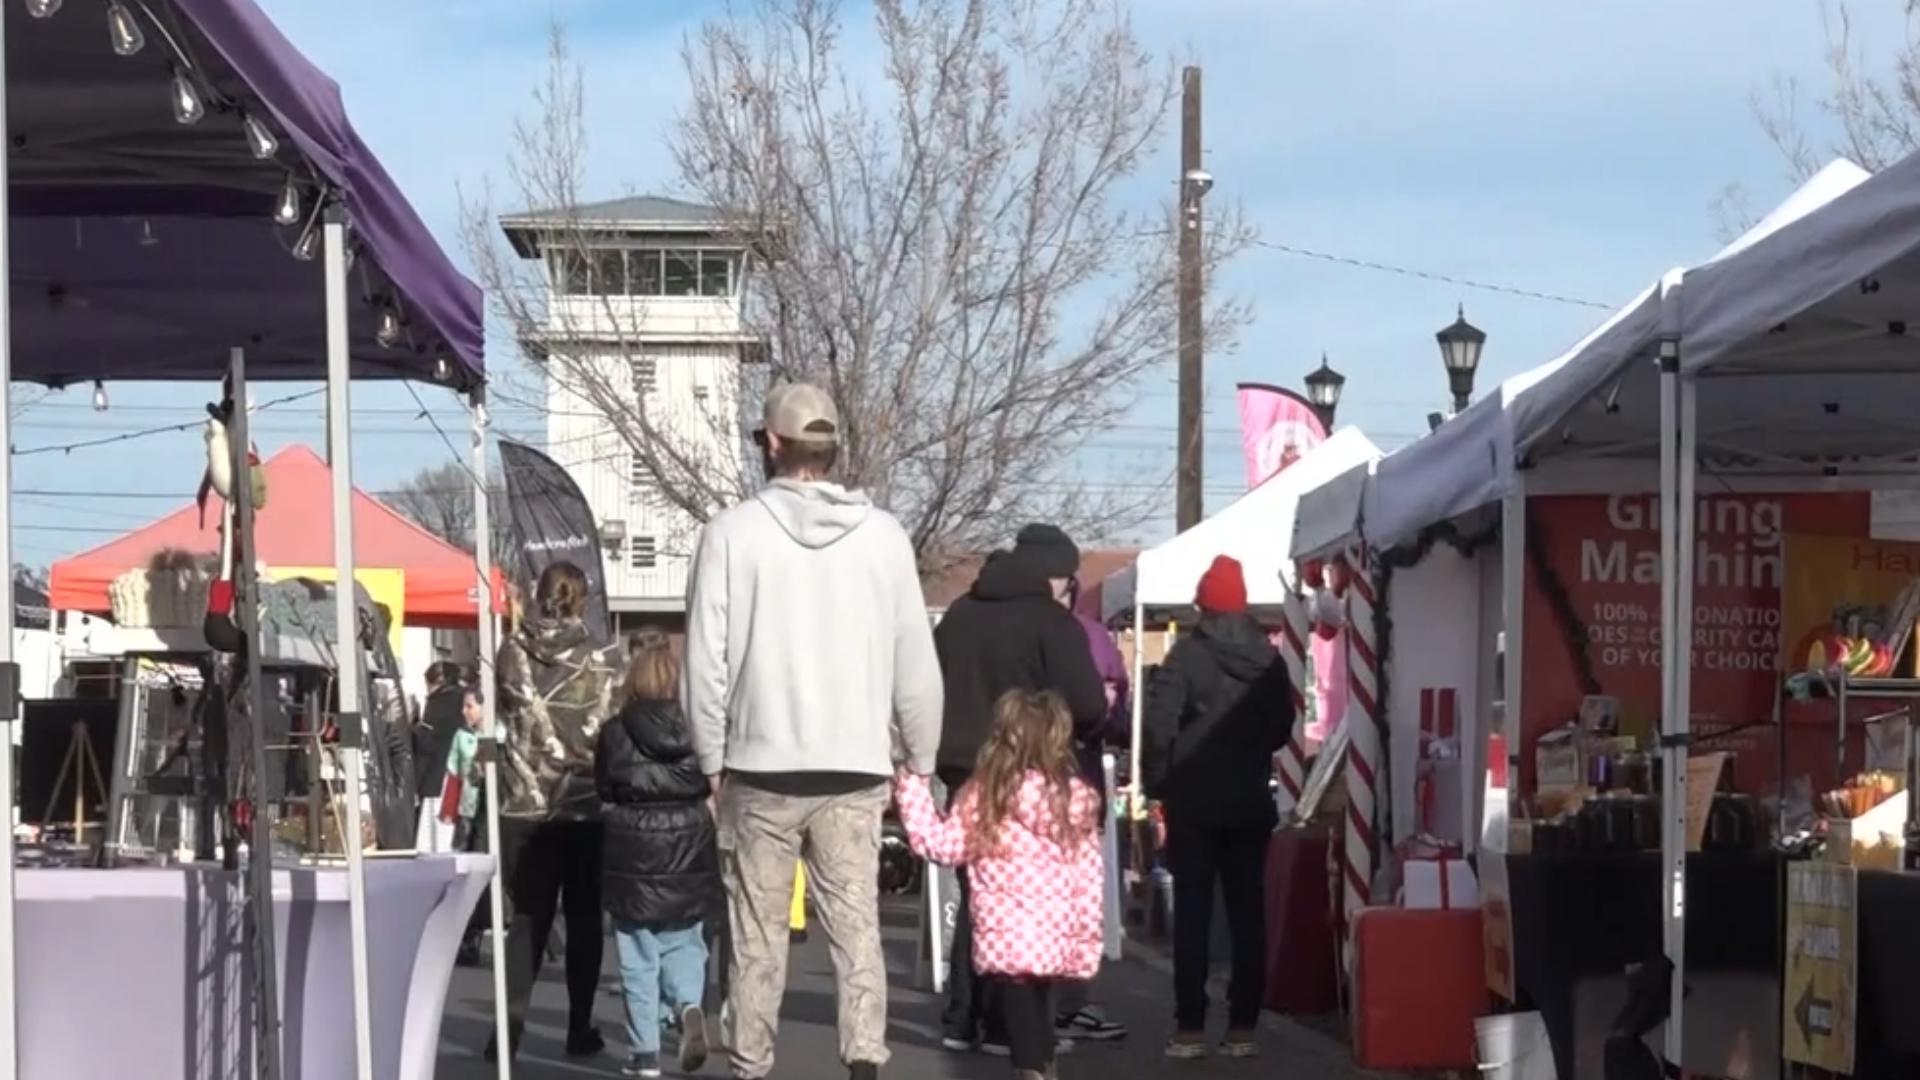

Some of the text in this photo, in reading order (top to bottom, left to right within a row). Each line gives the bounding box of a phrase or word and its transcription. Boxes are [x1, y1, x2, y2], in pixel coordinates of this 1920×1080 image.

[1607, 494, 1781, 546] Giing
[1581, 539, 1781, 589] Mahin
[1850, 543, 1920, 574] Ha
[1592, 602, 1649, 623] 100%
[1695, 606, 1779, 626] ONATIO
[1588, 625, 1628, 643] OES
[1649, 627, 1742, 647] CRITY
[1747, 630, 1779, 648] CA
[1602, 647, 1632, 665] OF
[1636, 648, 1697, 669] YOR
